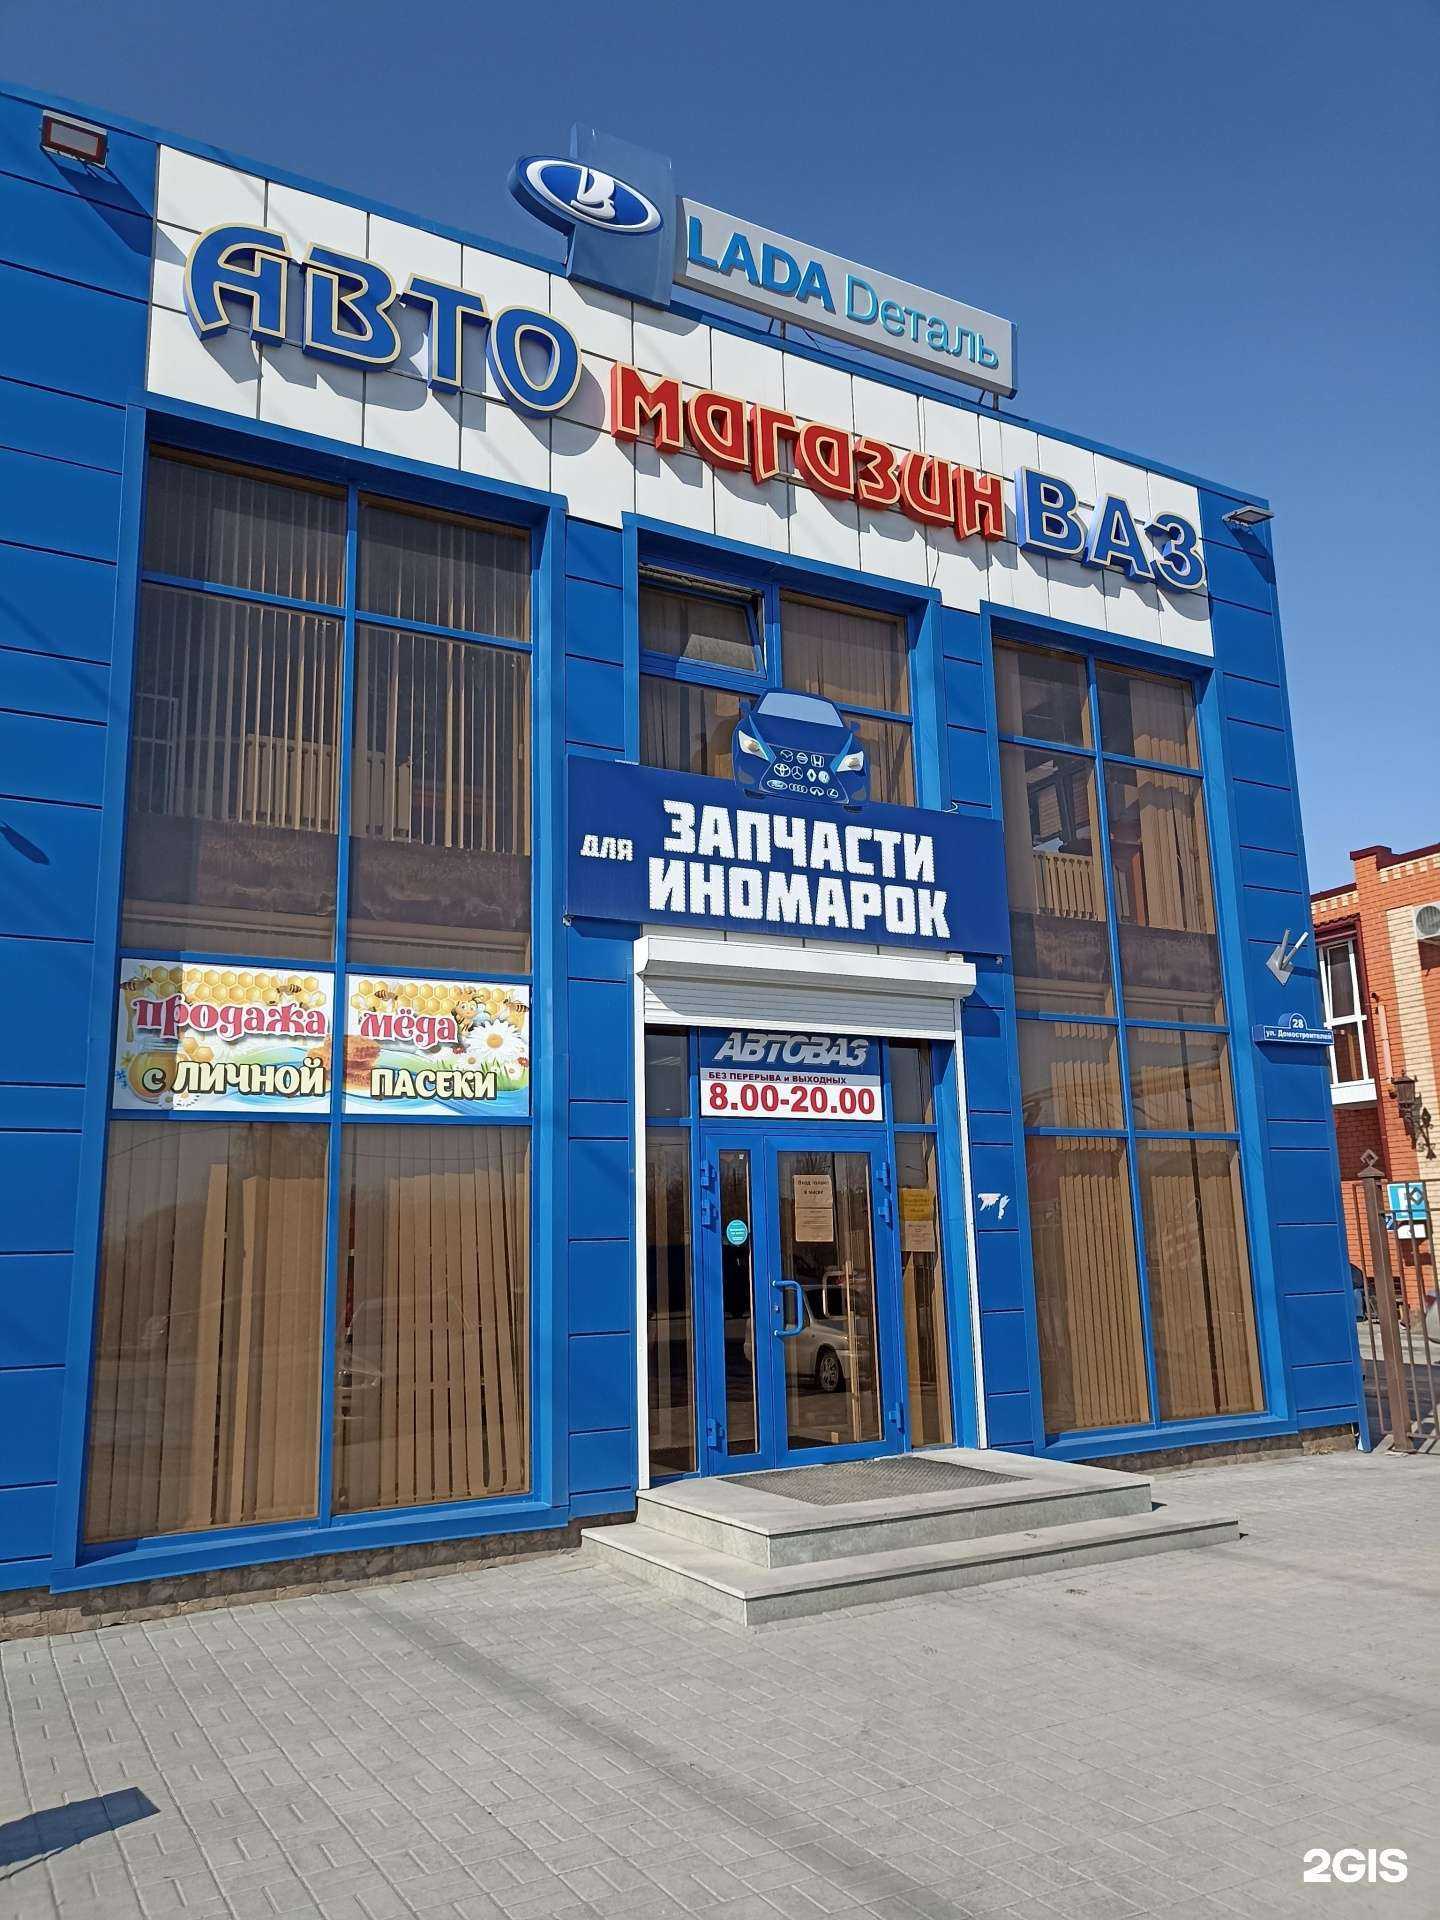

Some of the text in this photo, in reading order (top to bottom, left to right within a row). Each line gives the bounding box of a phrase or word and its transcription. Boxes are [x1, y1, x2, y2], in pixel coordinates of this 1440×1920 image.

[687, 214, 836, 313] LADA
[184, 222, 583, 419] АВТО
[1013, 465, 1208, 593] ВАЗ
[663, 799, 936, 883] ЗАПЧАСТИ
[648, 856, 951, 939] ИНОМАРОК
[132, 993, 459, 1050] продажа мёда
[1265, 1030, 1277, 1038] ул.
[1292, 1018, 1304, 1029] 28
[711, 1031, 869, 1067] АВТОВАЗ
[172, 1056, 328, 1098] ЛИЧНОЙ
[369, 1067, 499, 1101] ПАСЕКИ
[708, 1071, 727, 1080] БЕЗ
[729, 1072, 781, 1082] ПЕРЕРЫВА
[792, 1075, 847, 1085] ВЫХОДНЫХ
[709, 1082, 875, 1115] 8.00-20.00
